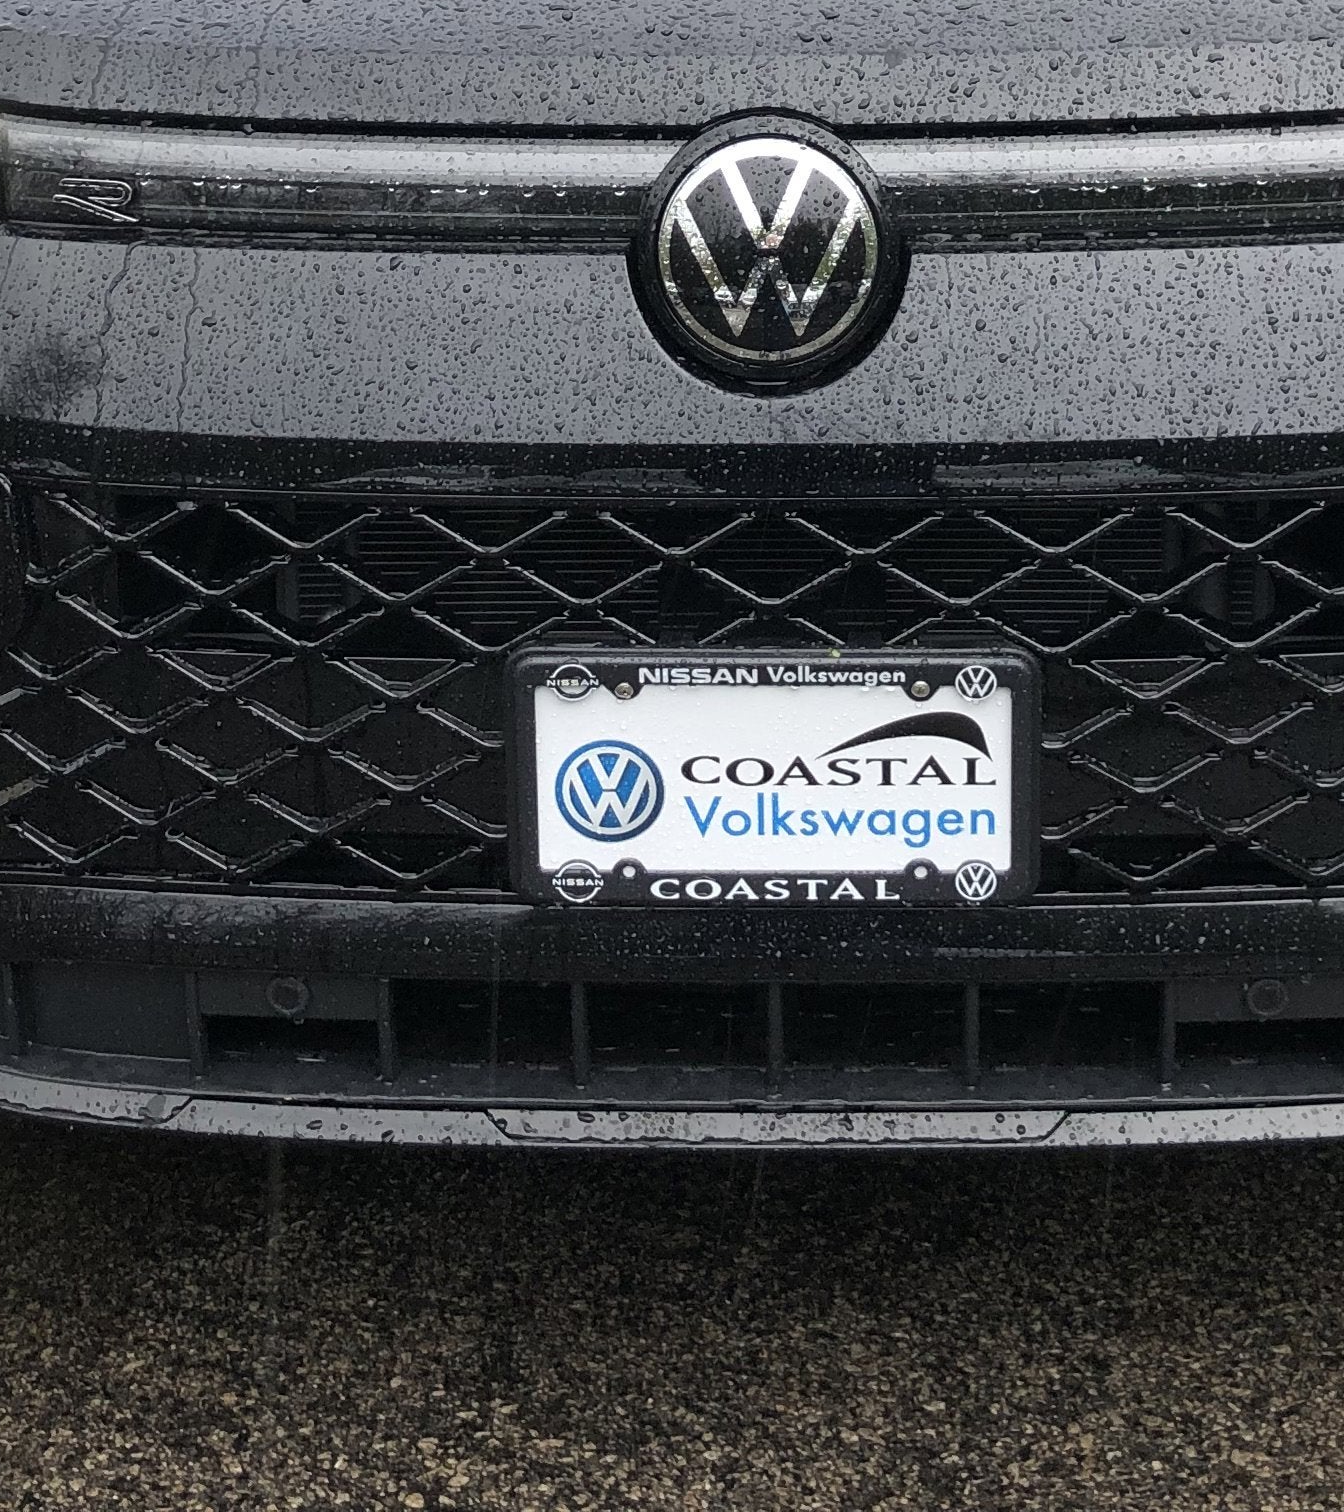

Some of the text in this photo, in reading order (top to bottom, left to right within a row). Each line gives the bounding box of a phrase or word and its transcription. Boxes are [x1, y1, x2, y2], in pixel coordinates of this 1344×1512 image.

[546, 678, 600, 687] NISSAN
[638, 665, 906, 686] NISSAN Volkswagen
[681, 755, 997, 786] COASTAL
[684, 792, 996, 848] Volkswagen
[552, 878, 604, 887] NISSAN
[650, 879, 900, 900] COASTAL
